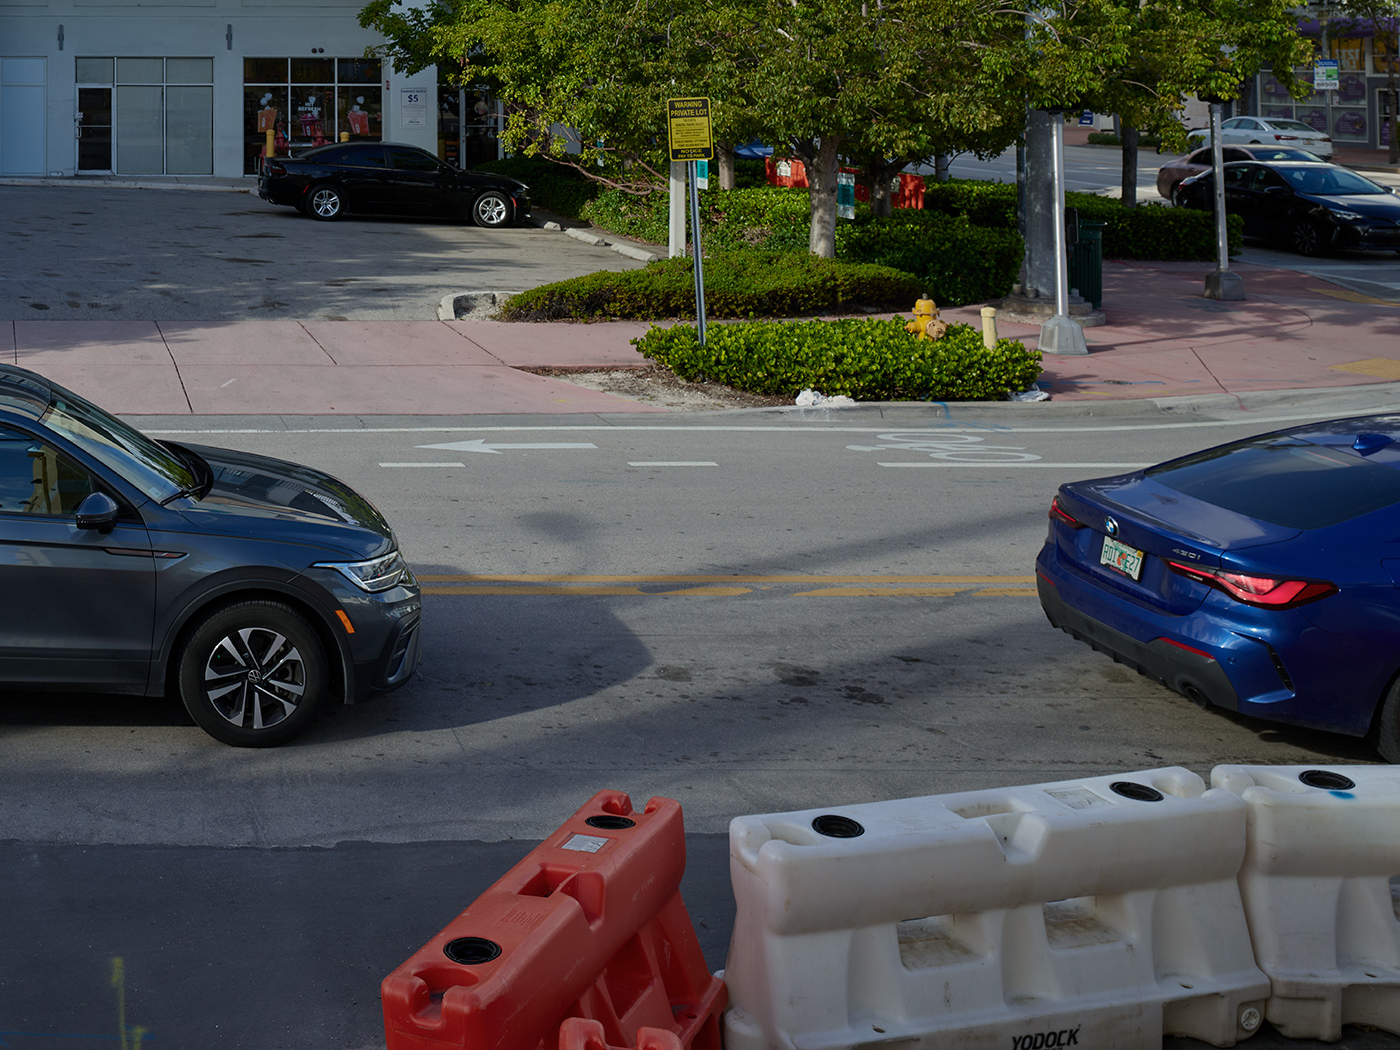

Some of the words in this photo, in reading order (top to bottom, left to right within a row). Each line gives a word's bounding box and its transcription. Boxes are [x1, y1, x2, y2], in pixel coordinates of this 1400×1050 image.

[407, 94, 419, 103] $5
[674, 101, 703, 109] WARNING
[671, 109, 695, 117] PRIVATE
[1012, 1028, 1081, 1050] YODOCK
